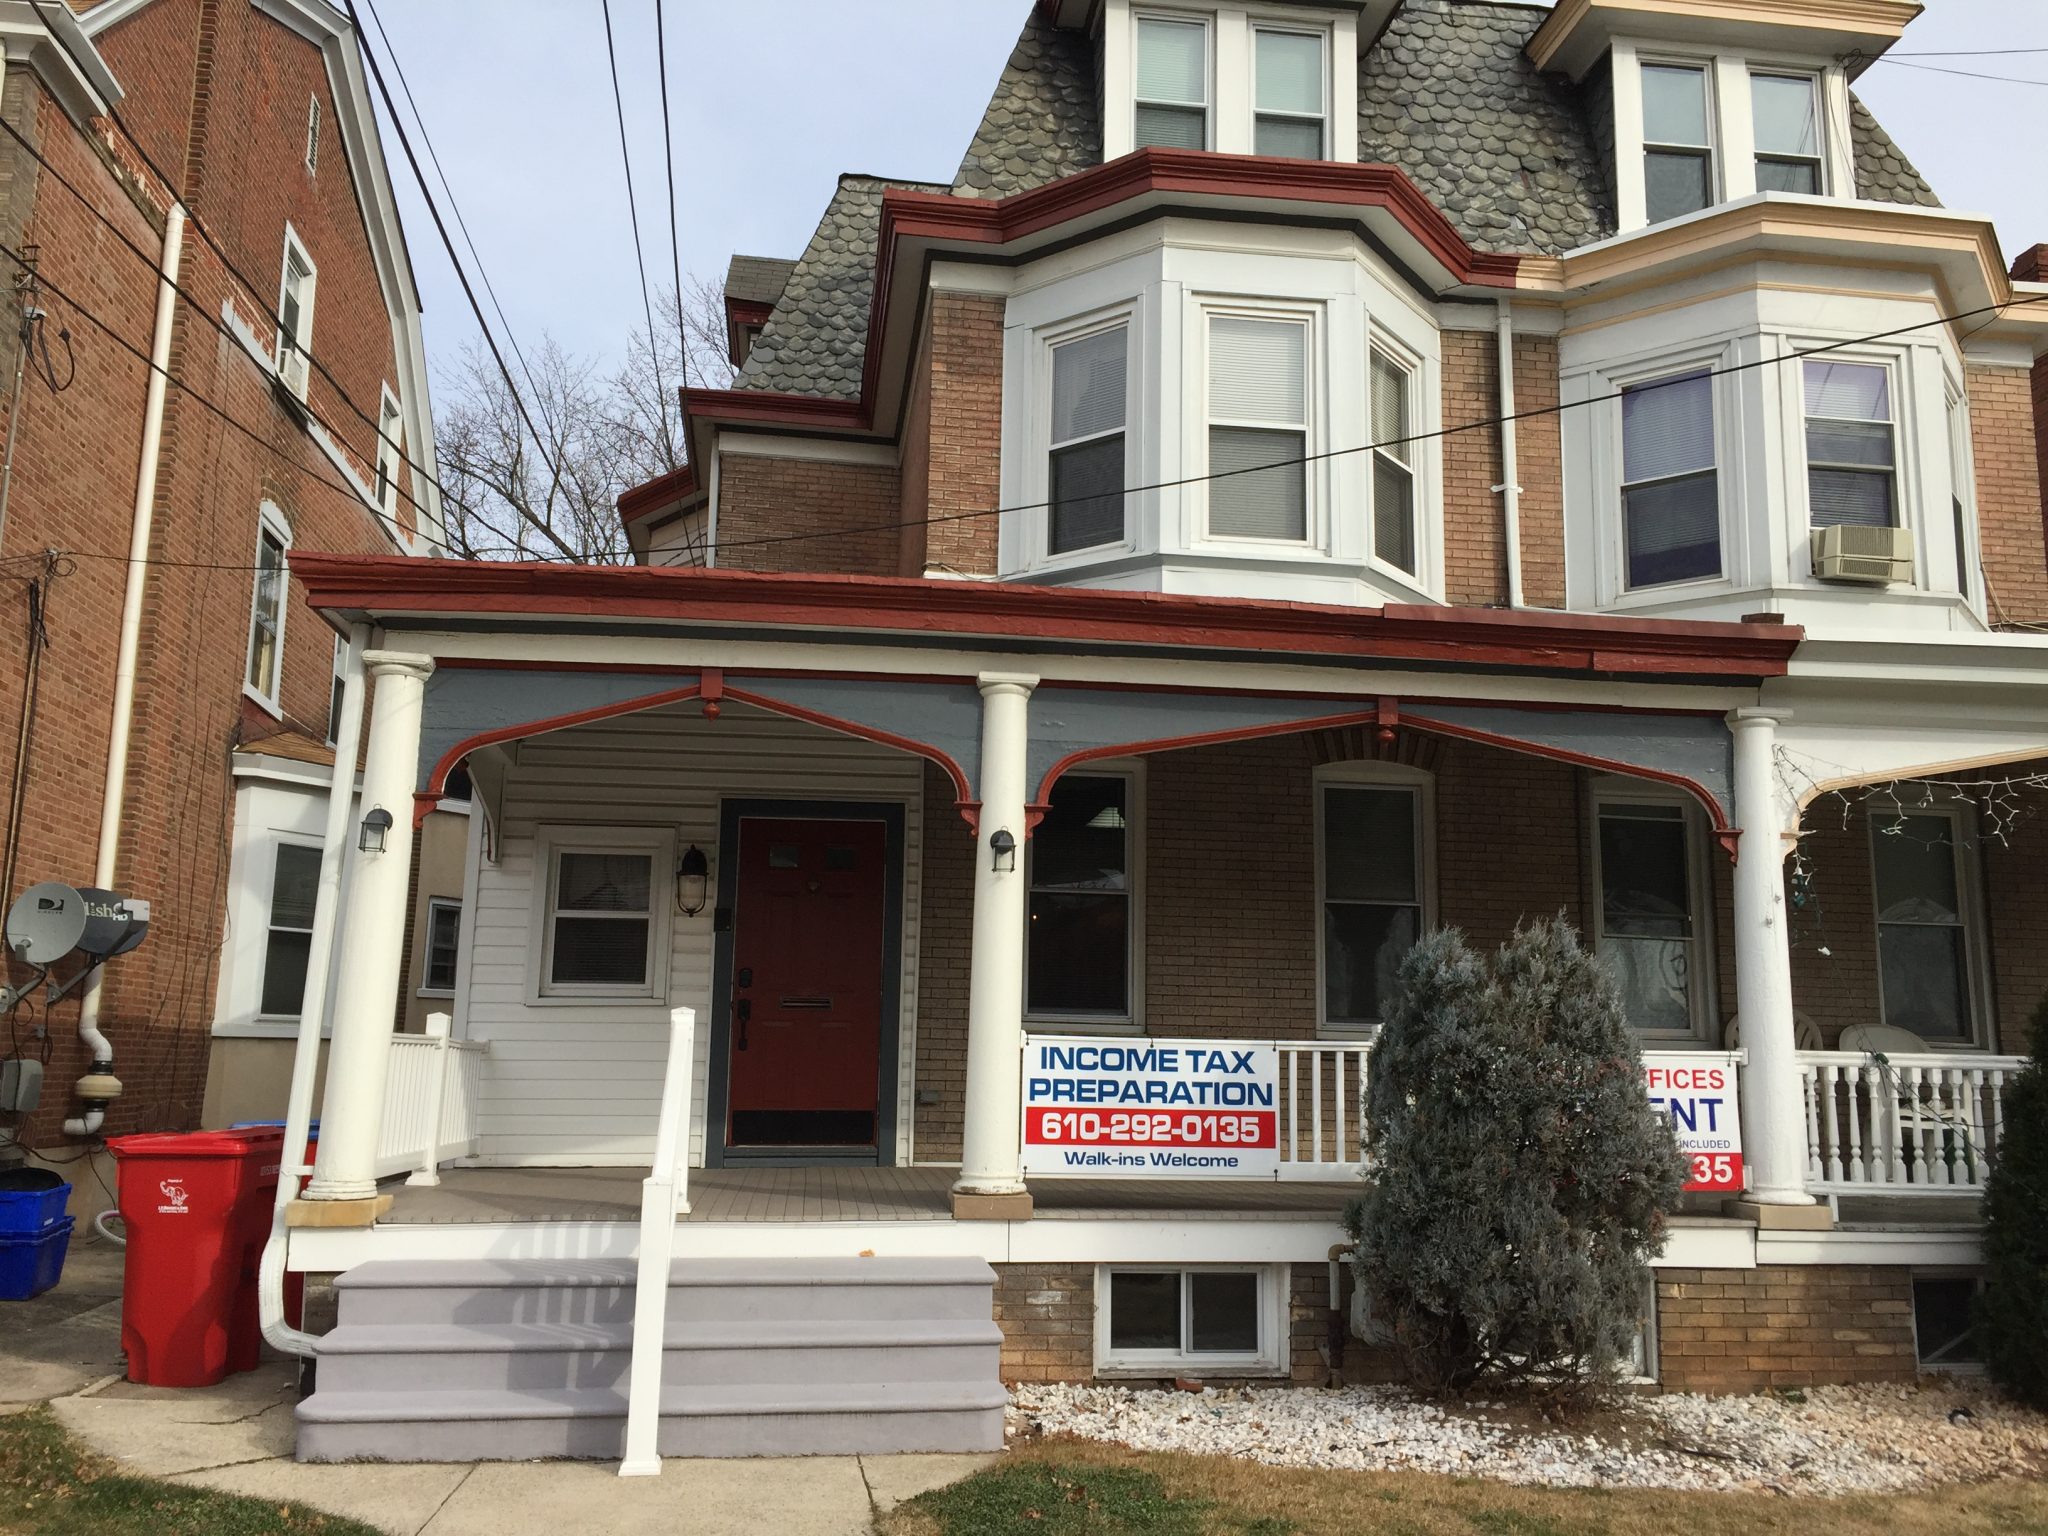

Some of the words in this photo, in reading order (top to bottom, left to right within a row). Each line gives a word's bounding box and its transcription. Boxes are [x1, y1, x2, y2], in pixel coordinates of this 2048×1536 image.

[1041, 1046, 1178, 1072] INCOME
[1185, 1050, 1255, 1074] TAX
[1029, 1078, 1273, 1106] PREPARATION
[1648, 1069, 1725, 1089] FICES
[1041, 1112, 1260, 1143] 610-292-0135
[1680, 1140, 1731, 1149] INCLUDED
[1064, 1151, 1145, 1166] Walk-ins
[1150, 1152, 1239, 1168] Welcome
[1694, 1155, 1733, 1184] 35
